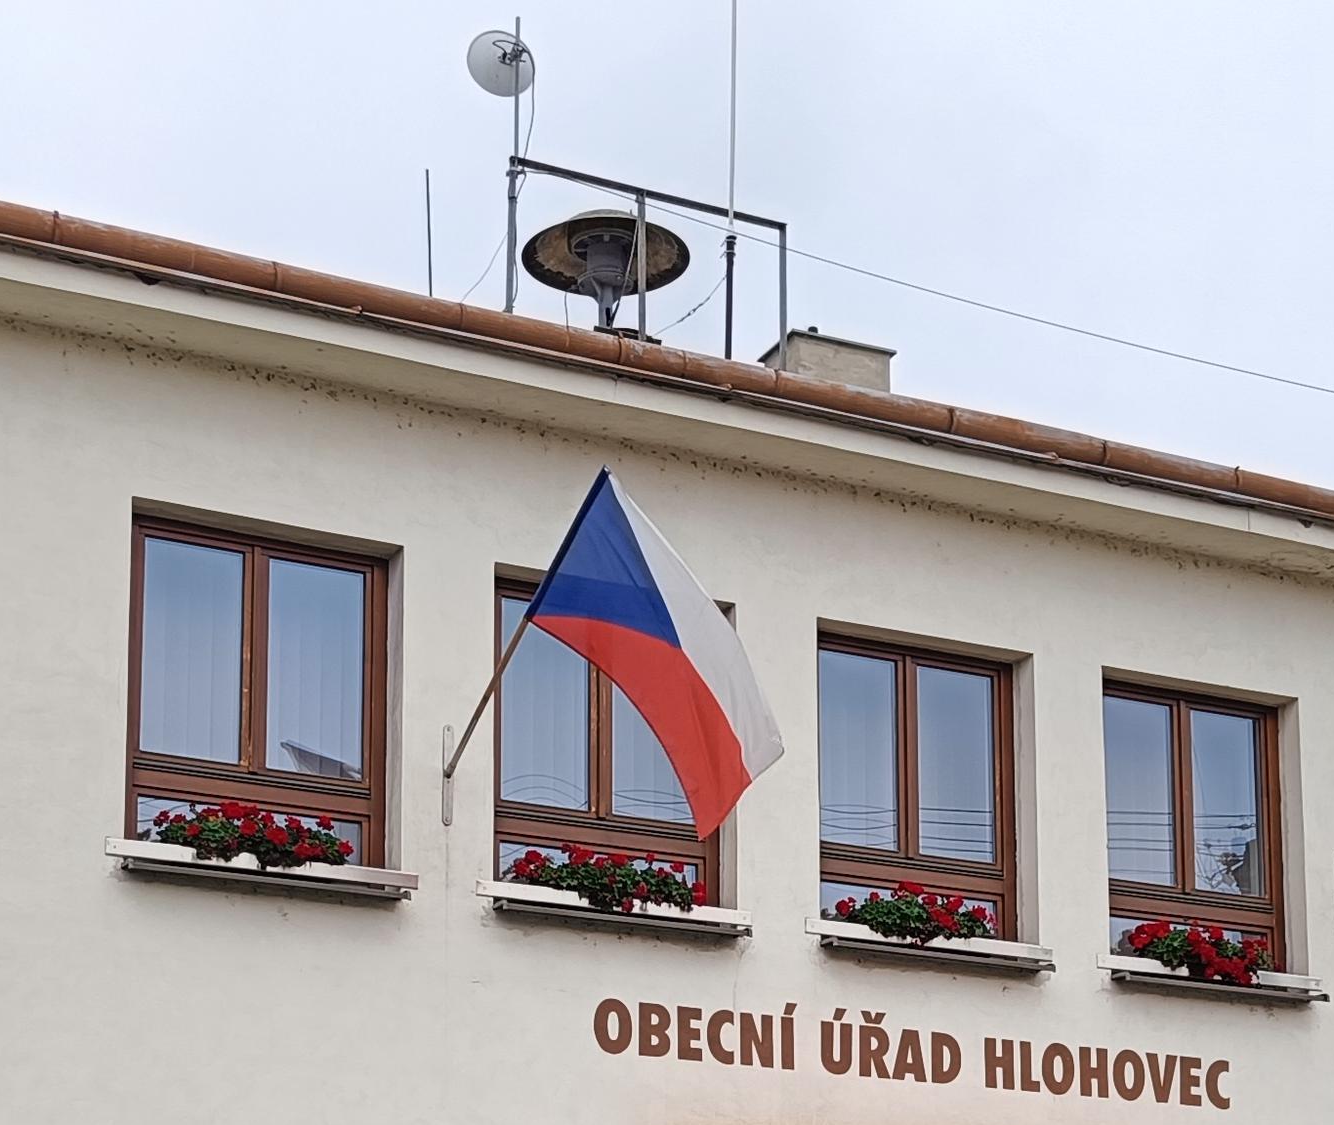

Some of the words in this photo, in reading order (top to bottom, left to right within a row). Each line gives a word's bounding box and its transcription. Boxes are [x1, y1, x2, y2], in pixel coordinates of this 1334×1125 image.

[593, 998, 797, 1070] OBECNÍ
[820, 1008, 962, 1085] ÚŘAD
[984, 1036, 1231, 1110] HLOHOVEC
